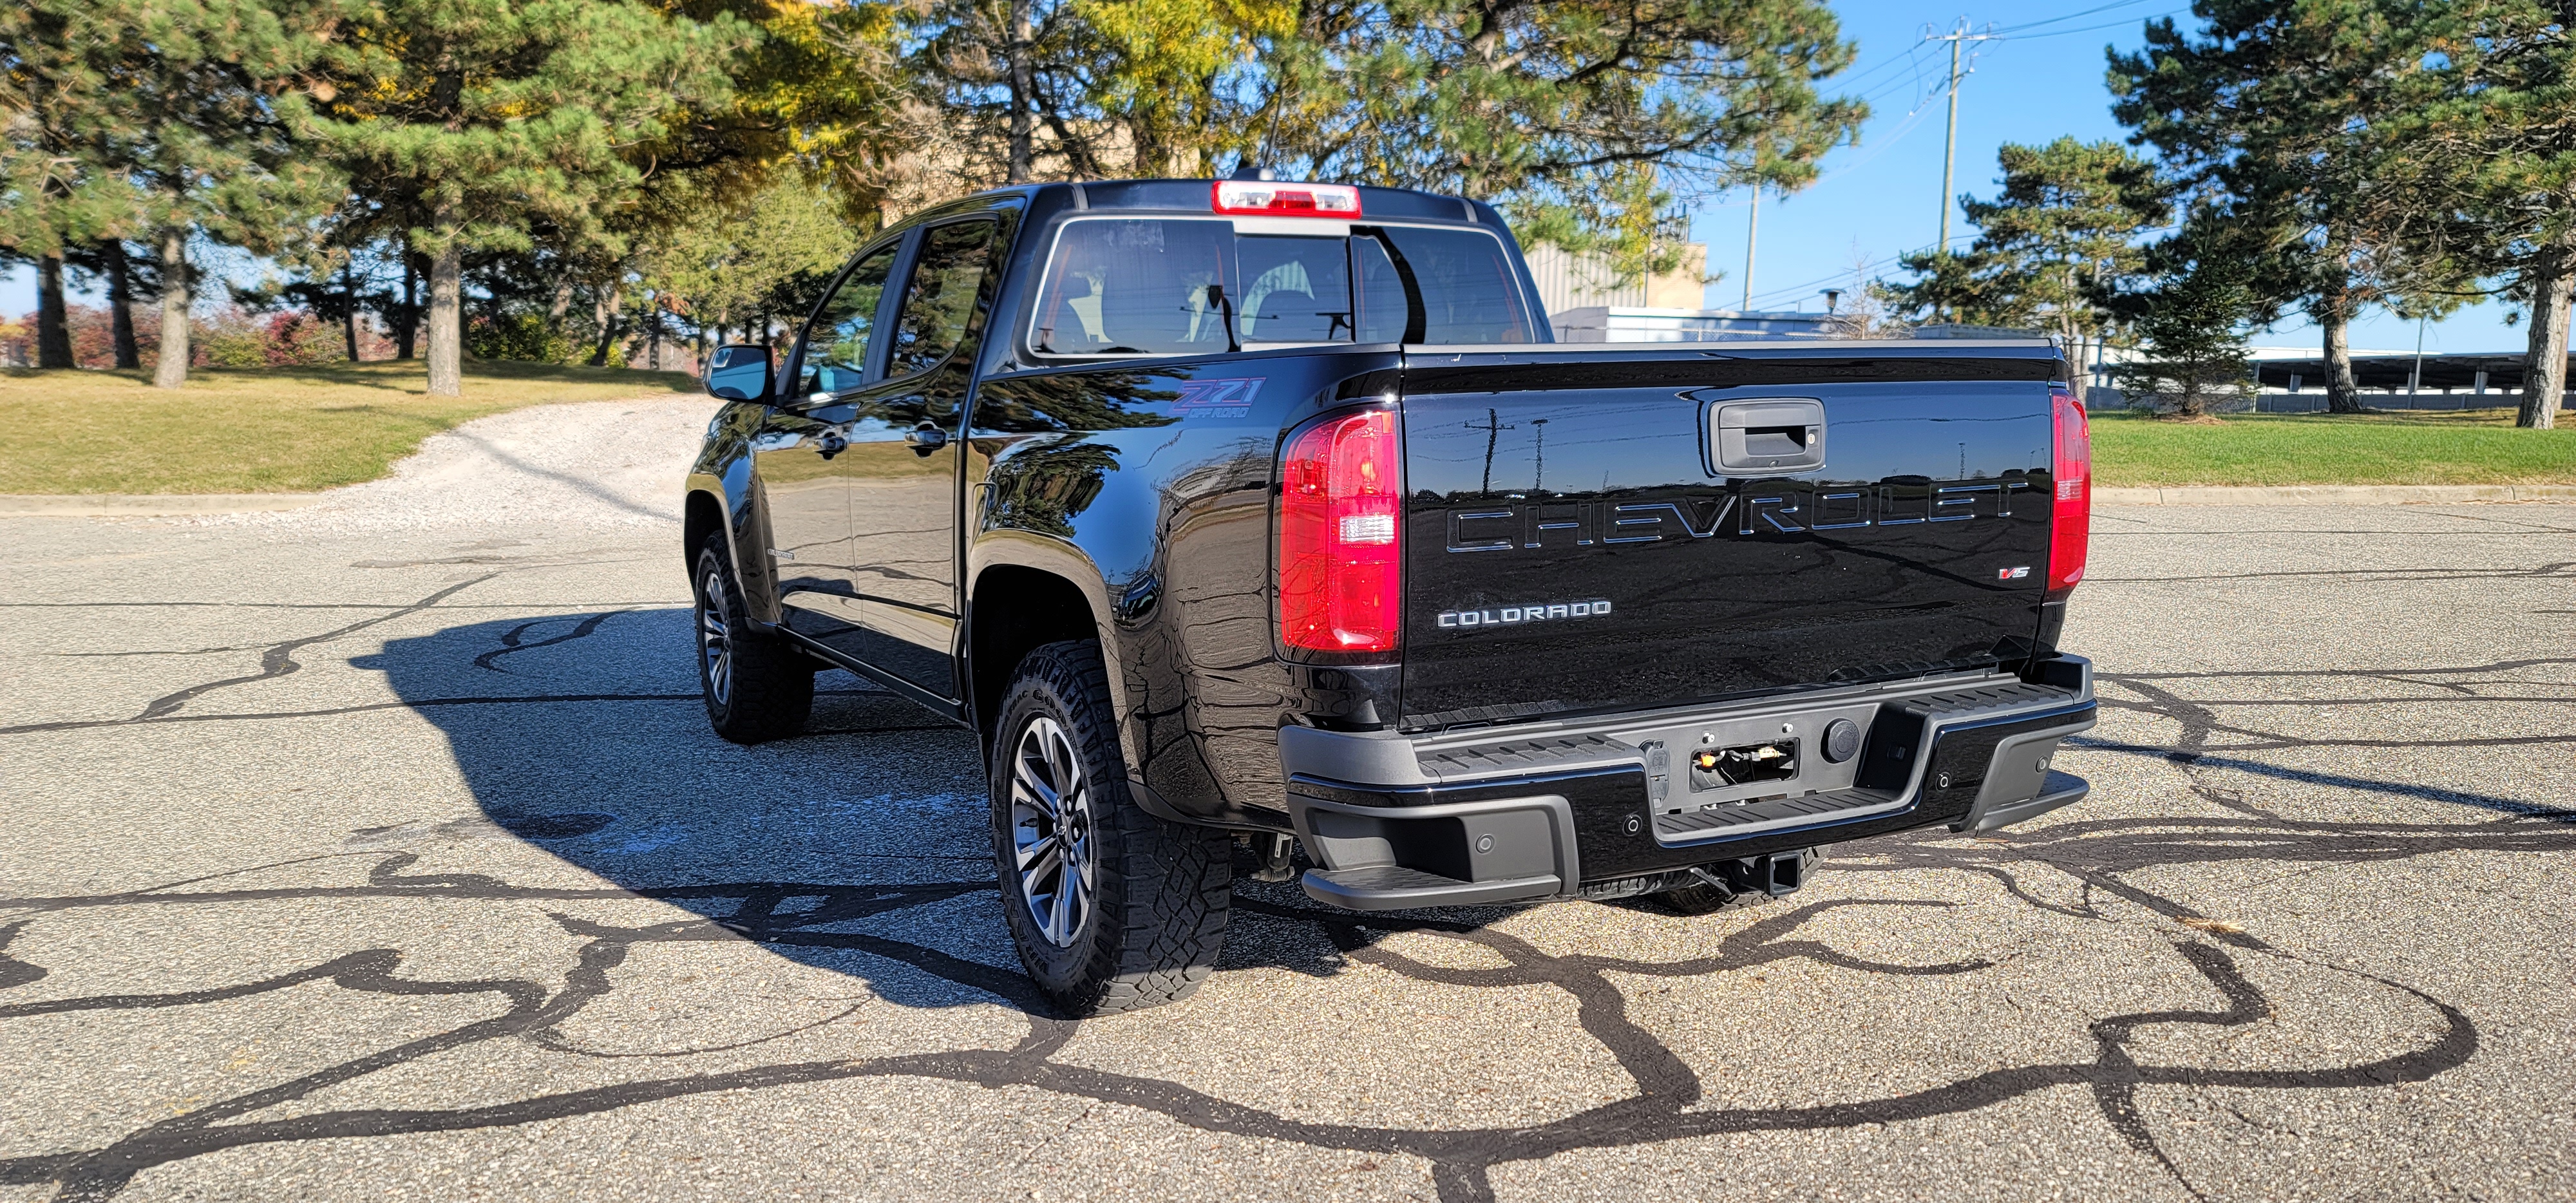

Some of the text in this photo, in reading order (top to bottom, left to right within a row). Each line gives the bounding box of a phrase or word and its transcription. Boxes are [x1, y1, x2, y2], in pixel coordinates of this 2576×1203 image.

[1170, 377, 1267, 413] Z71
[1189, 407, 1250, 418] OFF ROAD
[1446, 480, 2028, 553] CHEVROLET
[1999, 567, 2031, 580] V6
[1437, 601, 1611, 627] COLORADO
